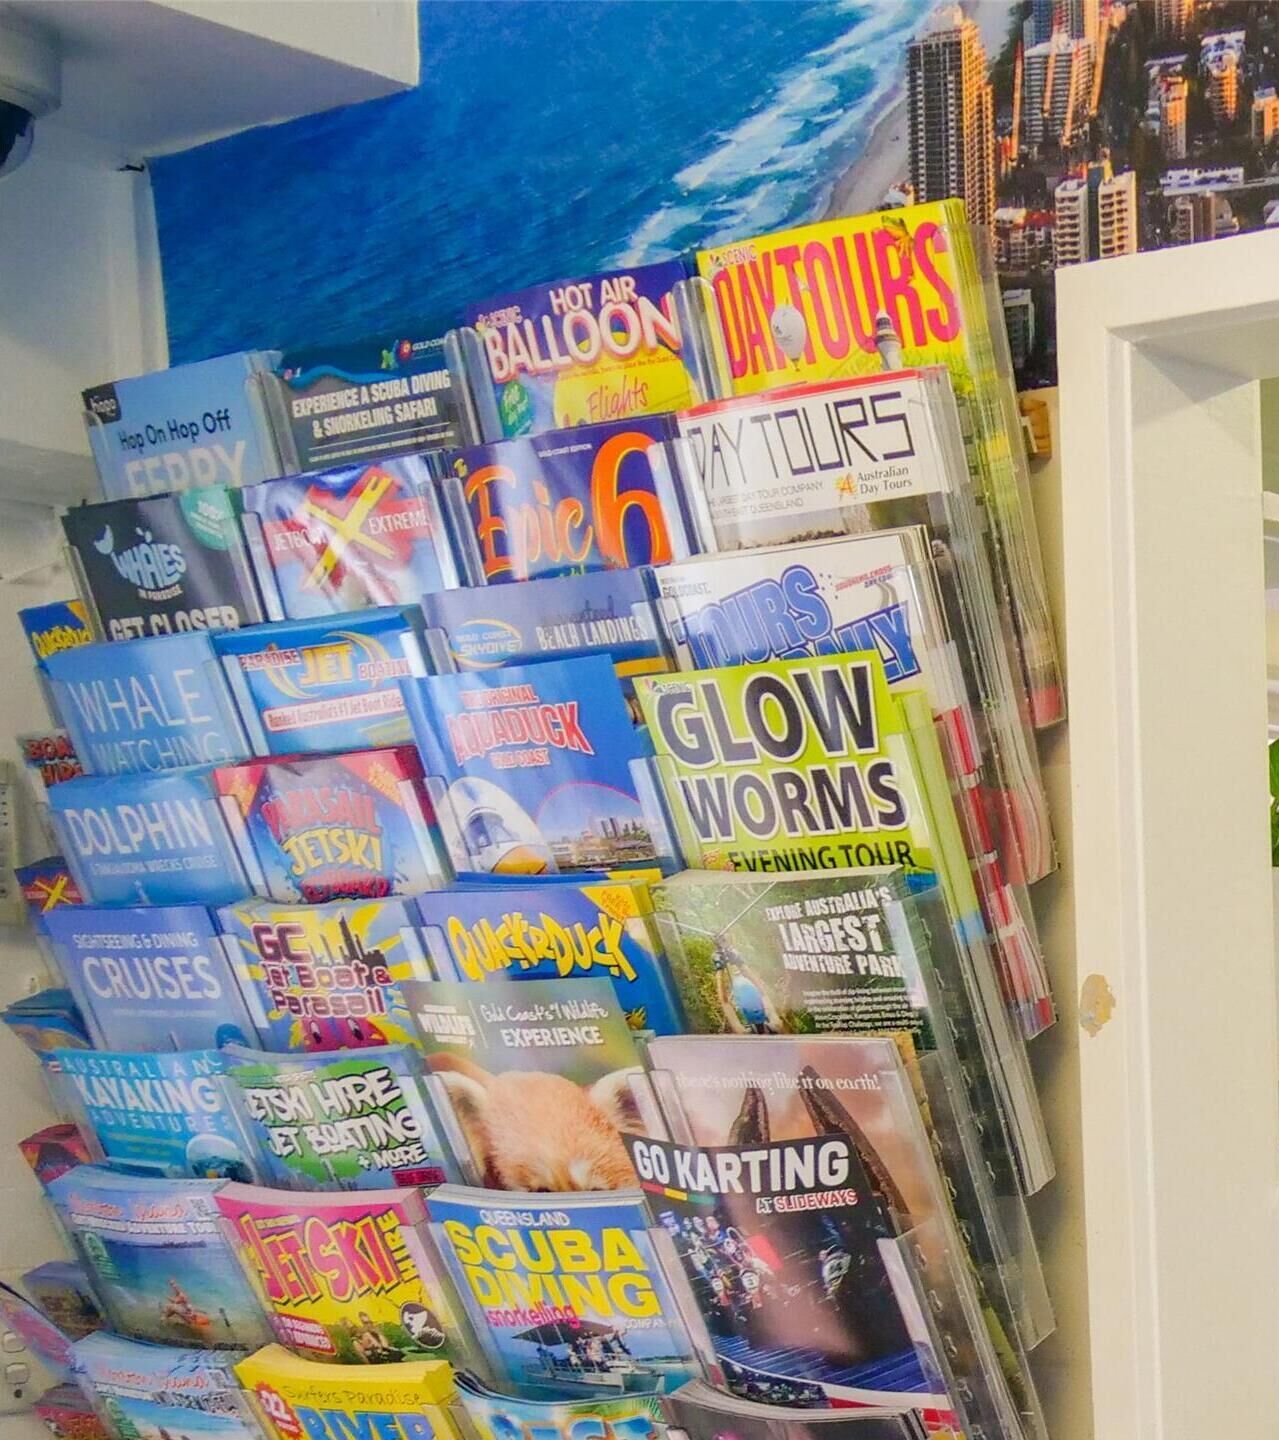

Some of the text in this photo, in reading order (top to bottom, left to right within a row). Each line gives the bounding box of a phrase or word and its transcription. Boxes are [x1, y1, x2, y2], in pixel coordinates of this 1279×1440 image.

[550, 276, 638, 316] HOT AIR
[483, 291, 682, 384] BALLOON
[292, 369, 451, 418] EXPERIENCE A SCUBA DIVING
[587, 374, 649, 422] Flights
[118, 408, 231, 454] Hop On Hop Off
[312, 397, 438, 439] & SNORKELING SAFARI
[750, 392, 916, 478] TOURS
[857, 465, 909, 483] Australian
[860, 478, 912, 495] Day Tours
[591, 431, 673, 570] 6
[584, 616, 649, 645] LANDINGS
[68, 669, 212, 733] WHALE
[655, 661, 881, 772] GLOW
[91, 732, 229, 776] WATCHING
[447, 701, 594, 767] AQUADUCK
[674, 761, 909, 843] WORMS
[64, 798, 214, 856] DOLPHIN
[283, 828, 383, 876] JETSKI
[728, 841, 916, 873] EVENING TOUR
[805, 887, 892, 916] AUSTRALIA'S
[780, 914, 884, 953] LARGEST
[83, 956, 222, 1001] CRUISES
[783, 953, 853, 974] ADVENTURE
[500, 1026, 604, 1047] EXPERIENCE
[73, 1073, 222, 1113] KAYAKING
[318, 1067, 402, 1114] HIRE
[262, 1108, 424, 1157] JET BOATING
[632, 1140, 850, 1195] GO KARTING
[479, 1209, 570, 1227] QUEENSLAND
[755, 1188, 858, 1214] AT SLIDEWAYS
[376, 1208, 420, 1284] HIRE
[444, 1219, 643, 1273] SCUBA
[470, 1267, 662, 1318] DIVING
